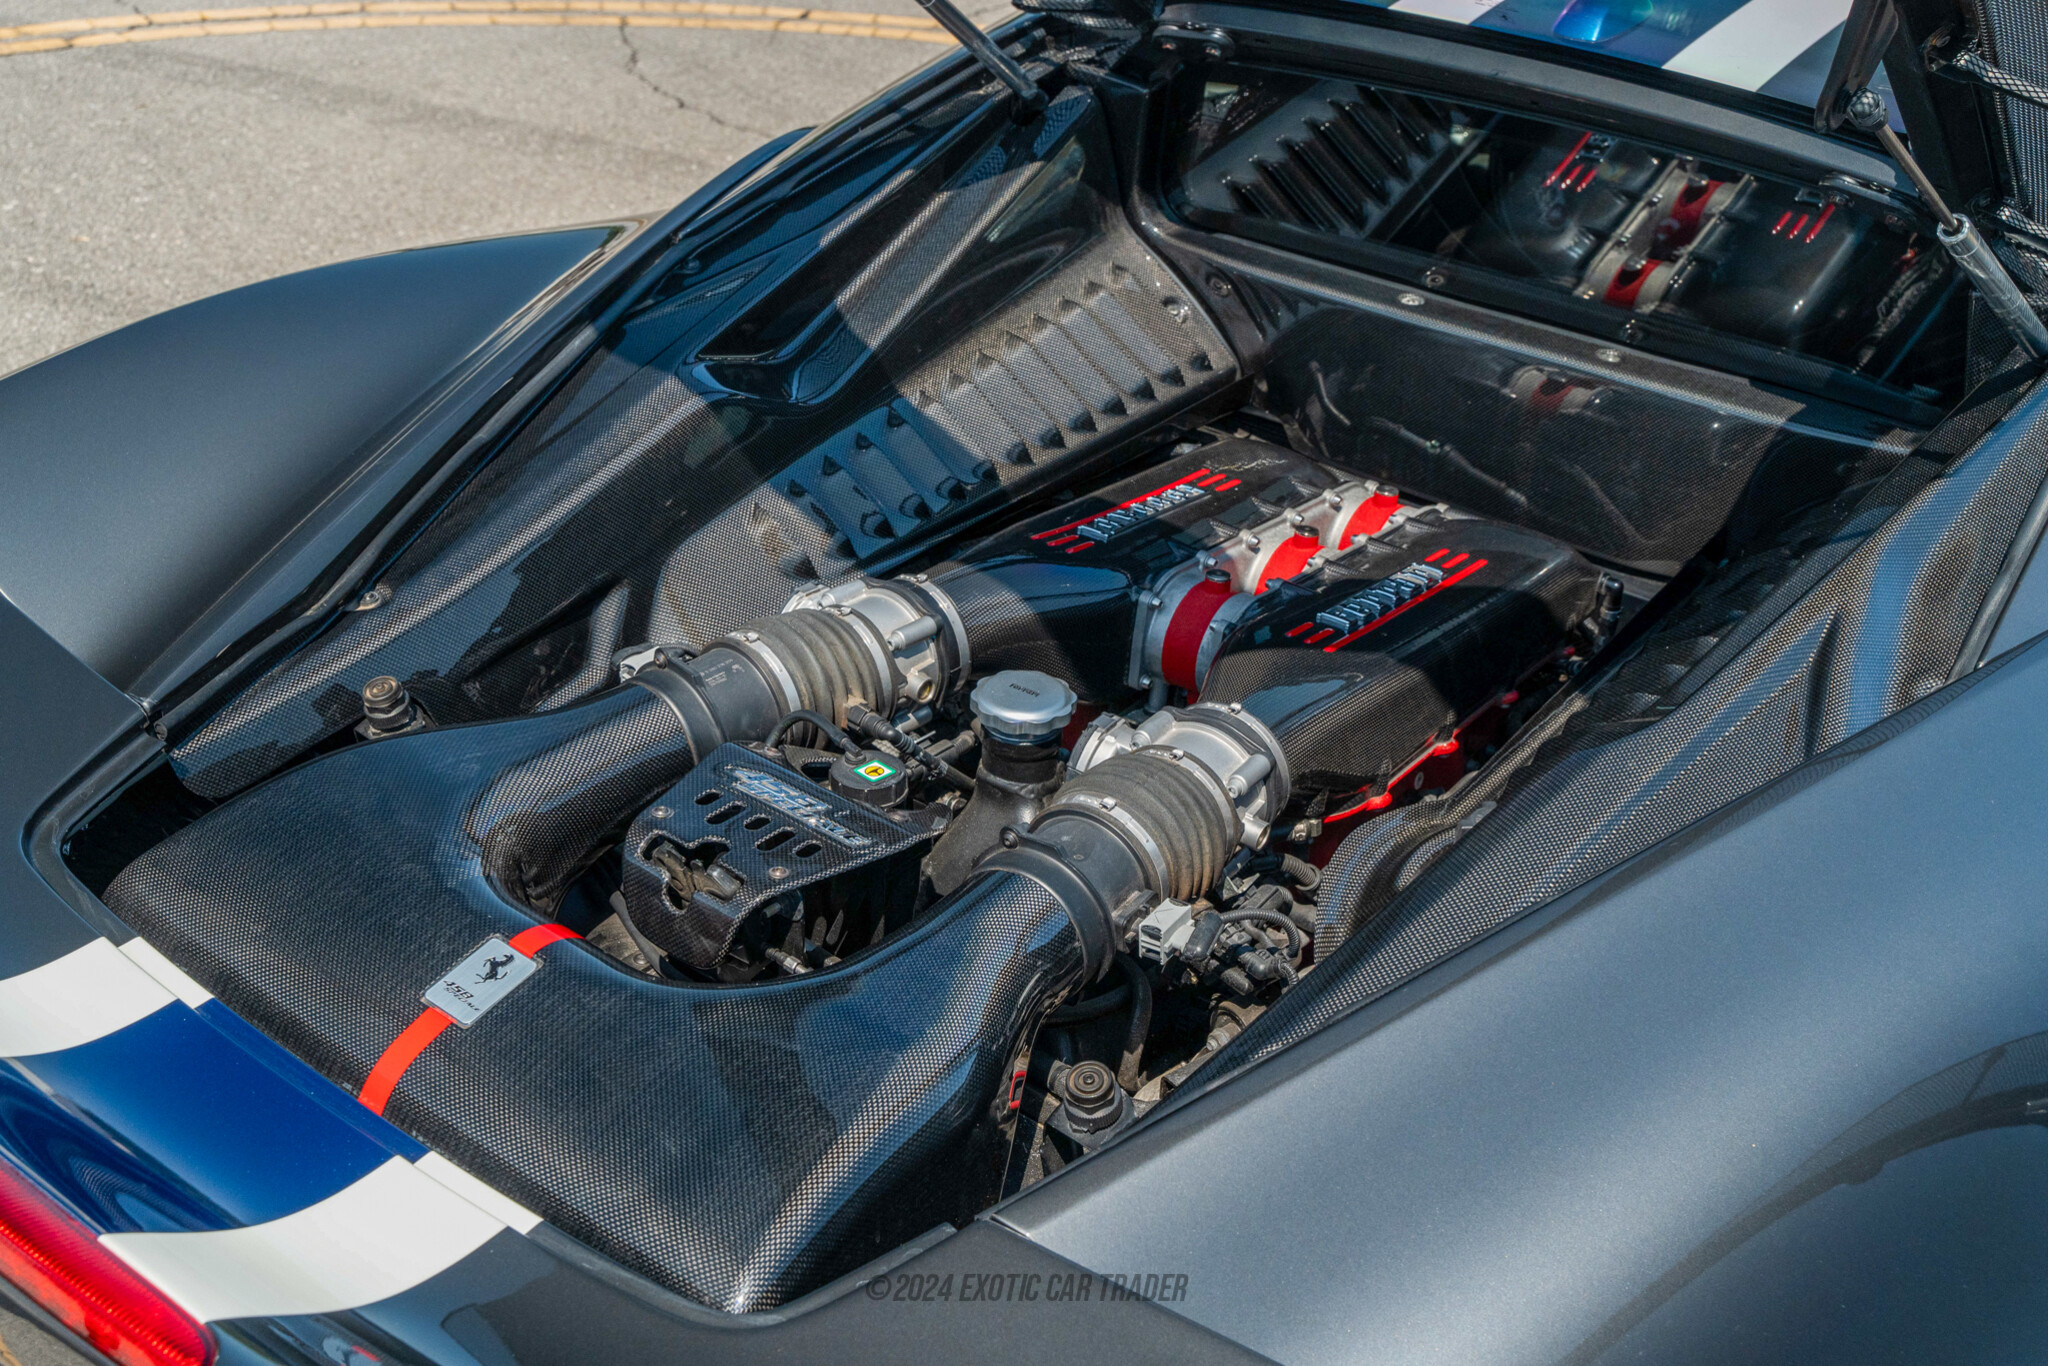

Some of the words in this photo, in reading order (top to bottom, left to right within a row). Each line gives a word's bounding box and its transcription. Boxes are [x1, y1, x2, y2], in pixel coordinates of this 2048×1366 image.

[1316, 562, 1445, 637] Ferrari
[1009, 683, 1040, 698] Ferrari
[443, 980, 475, 999] 458
